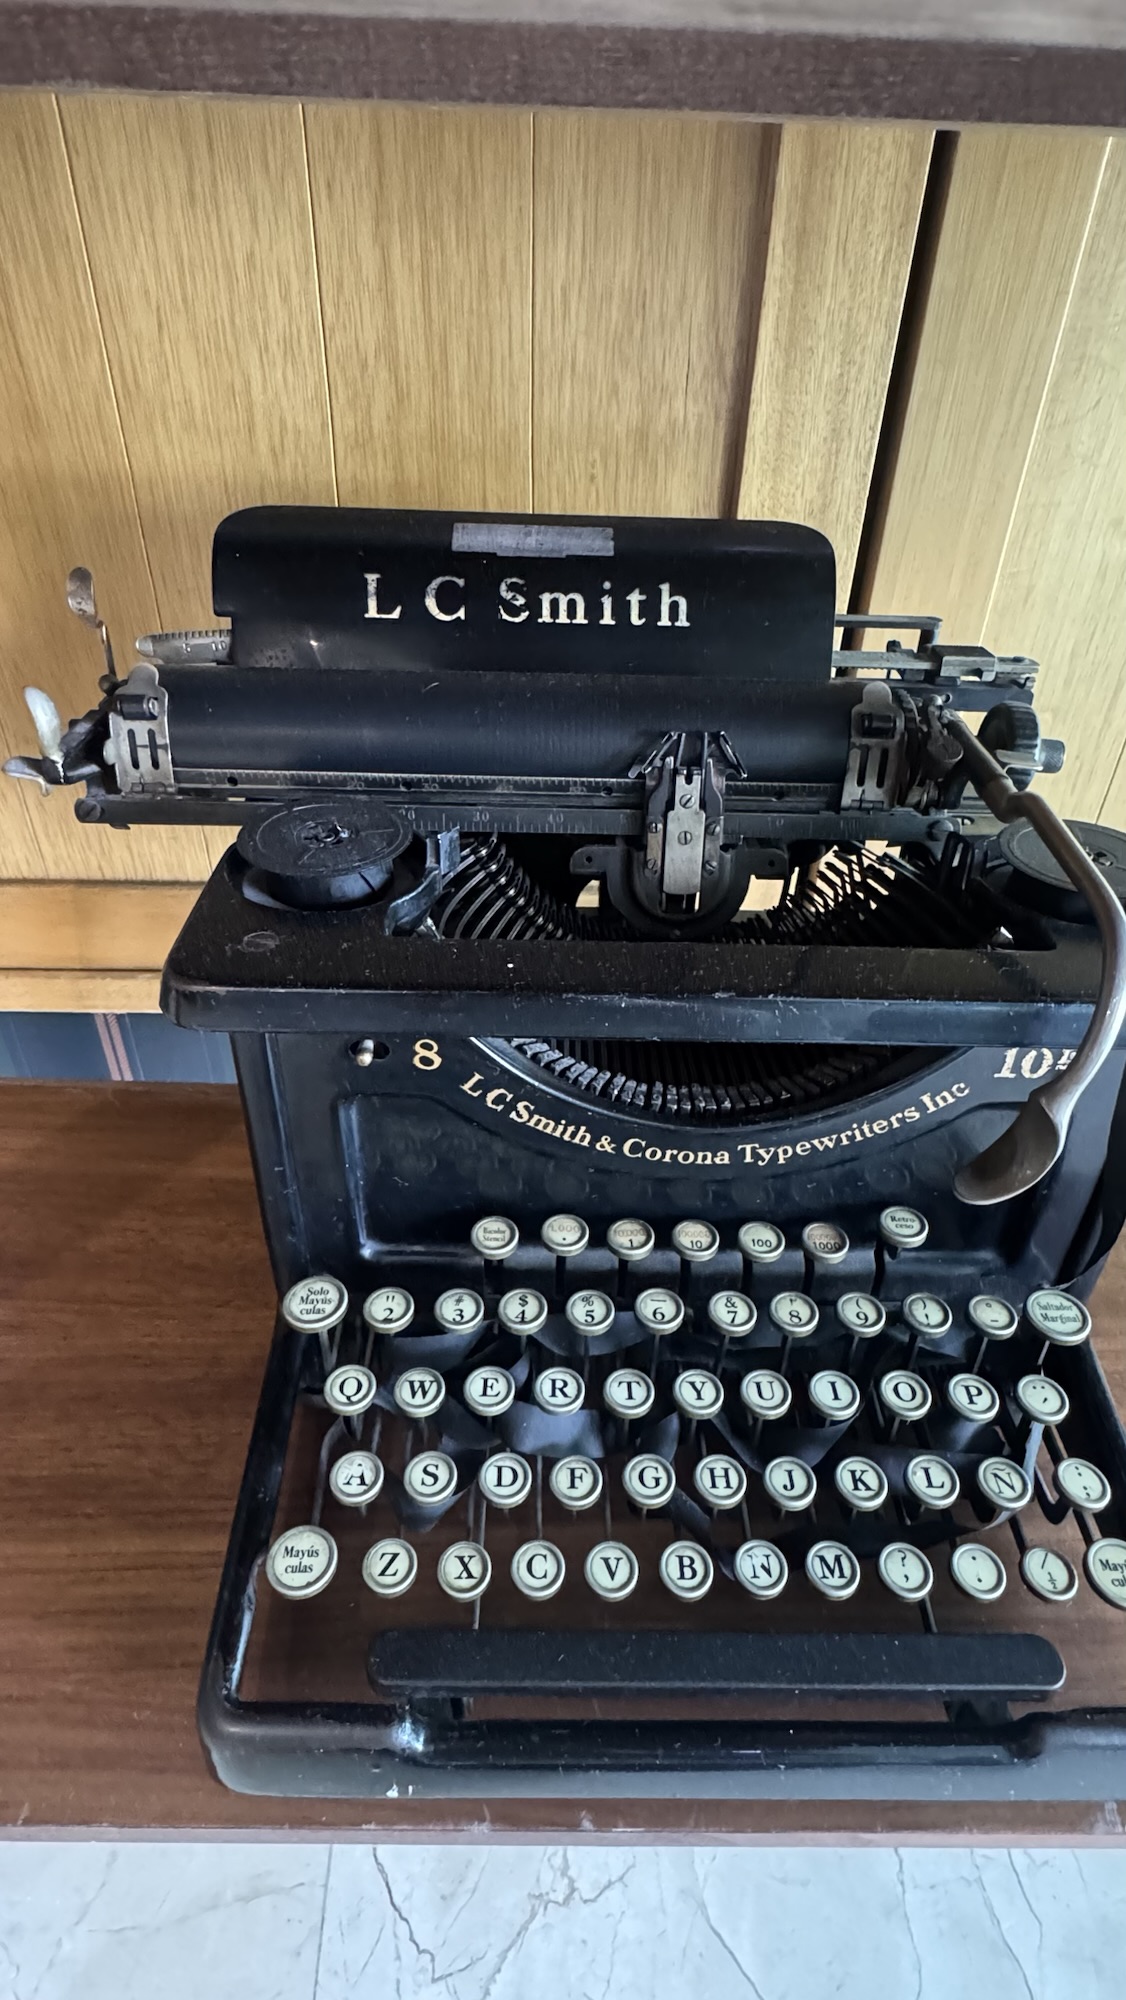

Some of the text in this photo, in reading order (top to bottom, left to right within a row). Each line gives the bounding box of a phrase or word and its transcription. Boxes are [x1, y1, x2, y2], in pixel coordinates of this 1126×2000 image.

[363, 572, 691, 627] L C Smith
[412, 1038, 442, 1071] 8
[509, 1100, 592, 1148] Smith
[595, 1135, 617, 1154] &
[622, 1138, 730, 1165] Corona
[737, 1107, 921, 1166] Typewriters
[922, 1081, 970, 1115] Inc
[628, 1238, 635, 1248] 1
[690, 1240, 703, 1249] 10
[751, 1238, 772, 1248] 100
[812, 1241, 841, 1251] 1000
[307, 1286, 330, 1296] Solo
[299, 1304, 327, 1315] culas
[382, 1308, 395, 1322] 2
[452, 1308, 465, 1323] 3
[515, 1309, 528, 1323] 4
[652, 1306, 666, 1321] 6
[1036, 1301, 1074, 1311] Saltador
[584, 1310, 596, 1324] 5
[727, 1311, 738, 1324] 7
[788, 1310, 802, 1324] 8
[856, 1311, 869, 1325] 9
[1040, 1313, 1081, 1324] Marginal
[339, 1376, 363, 1402] Q
[406, 1379, 436, 1400] W
[479, 1377, 501, 1398] E
[548, 1378, 572, 1399] R
[617, 1380, 642, 1400] T
[685, 1380, 708, 1401] Y
[753, 1381, 775, 1401] U
[827, 1381, 842, 1401] I
[892, 1381, 917, 1402] O
[961, 1384, 984, 1405] P
[342, 1463, 368, 1487] A
[421, 1463, 439, 1487] S
[493, 1465, 519, 1488] D
[566, 1467, 589, 1490] F
[638, 1466, 663, 1490] G
[706, 1467, 734, 1490] H
[782, 1469, 796, 1491] J
[847, 1469, 876, 1491] K
[920, 1466, 945, 1489] L
[990, 1467, 1017, 1494] Ñ
[282, 1545, 320, 1560] Mayús
[284, 1561, 314, 1574] culas
[377, 1552, 400, 1577] Z
[454, 1554, 478, 1580] X
[526, 1553, 548, 1579] C
[600, 1557, 624, 1581] V
[675, 1554, 698, 1580] B
[747, 1554, 773, 1579] N
[815, 1554, 848, 1579] M
